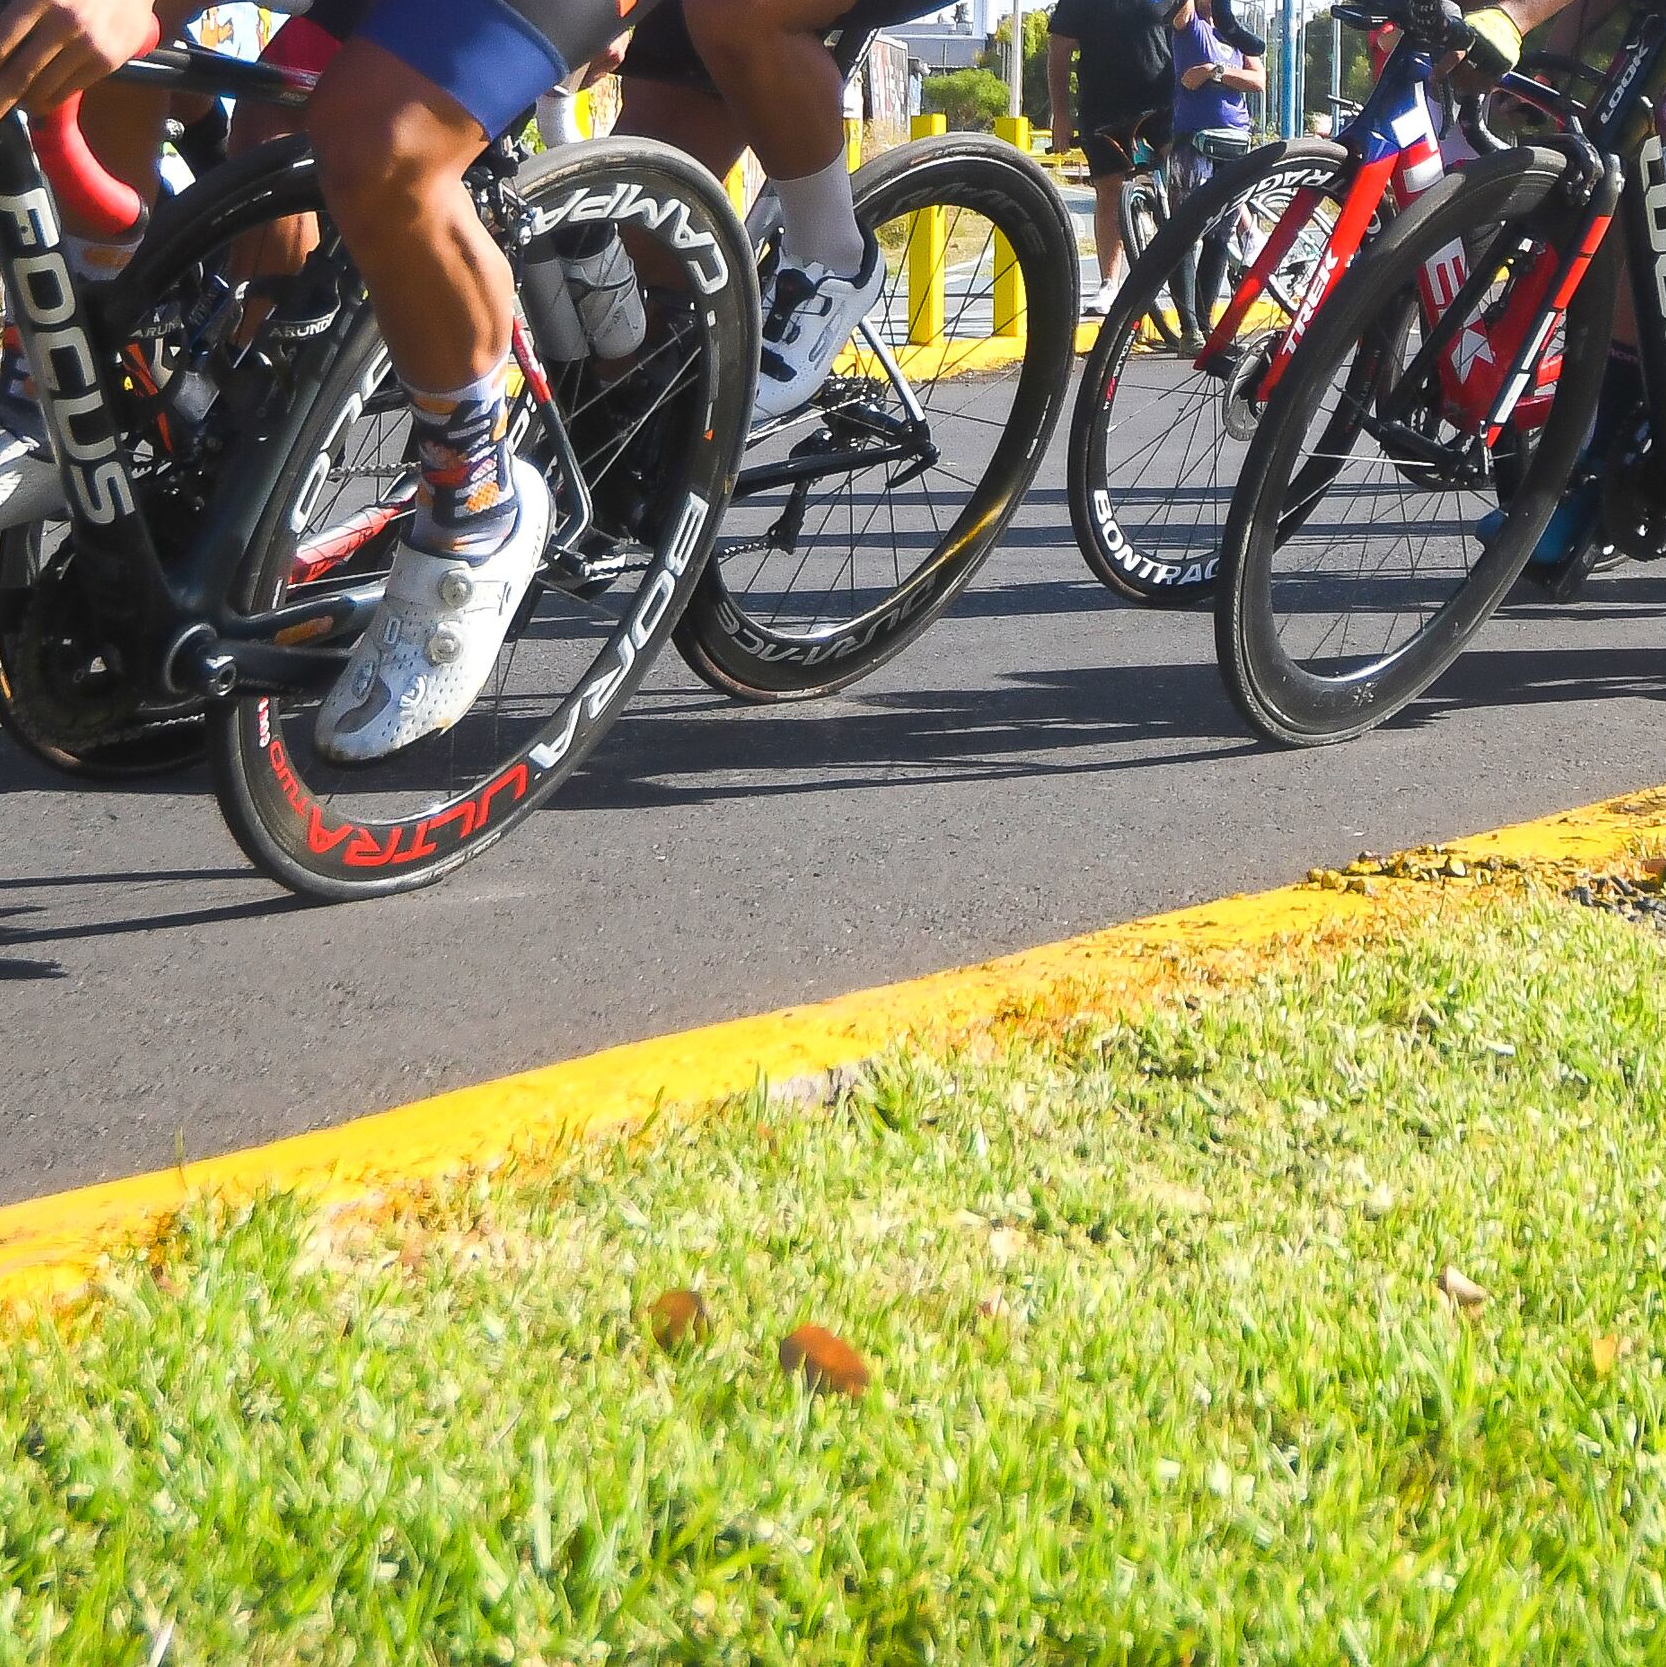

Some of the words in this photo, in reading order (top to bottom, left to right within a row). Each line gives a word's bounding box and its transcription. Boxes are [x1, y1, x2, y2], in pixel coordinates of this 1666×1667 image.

[1600, 42, 1650, 125] LOOK
[1282, 247, 1339, 356] TREK
[532, 489, 710, 771] BORA
[268, 739, 313, 820] TWO
[305, 760, 531, 869] ULTRA
